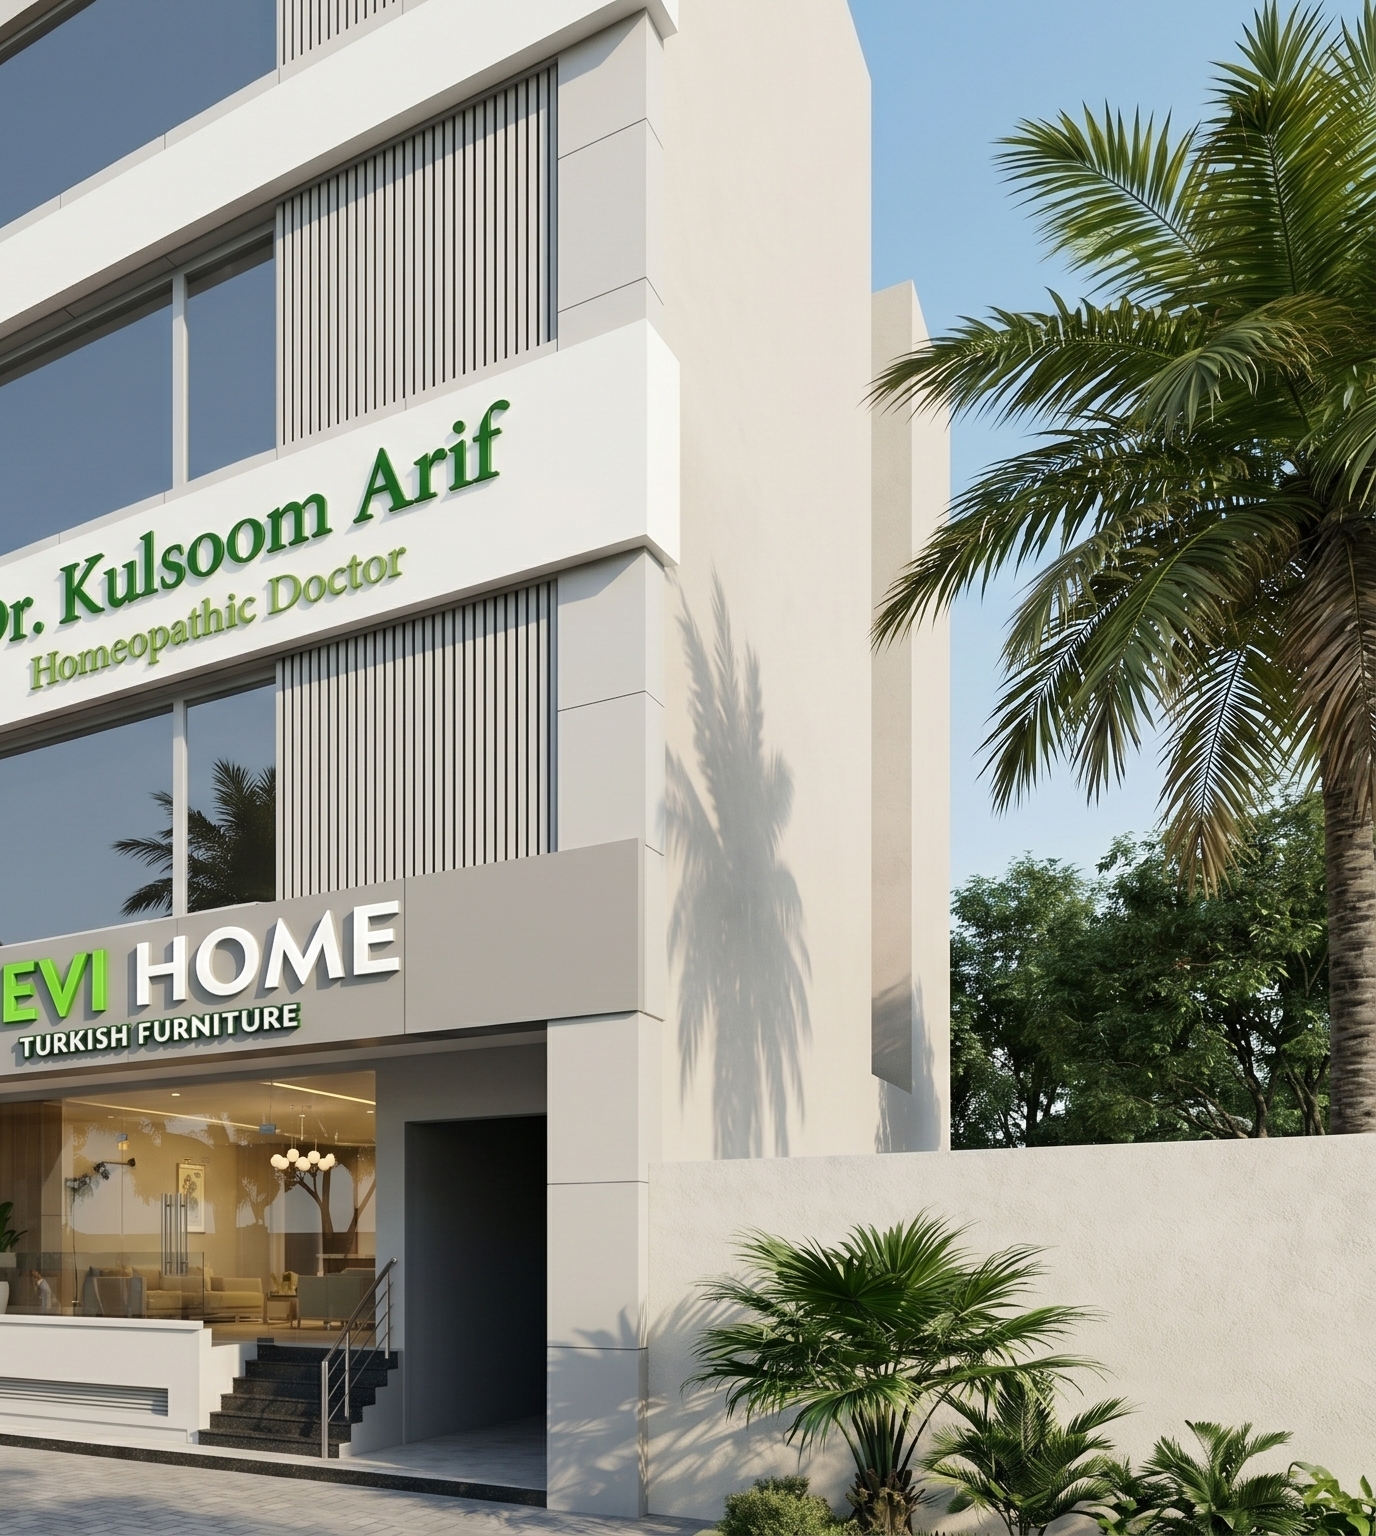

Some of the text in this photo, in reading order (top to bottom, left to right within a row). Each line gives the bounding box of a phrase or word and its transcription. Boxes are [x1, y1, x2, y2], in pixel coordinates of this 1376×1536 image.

[59, 492, 333, 625] Kulsoom
[353, 399, 511, 525] Arif
[30, 546, 407, 692] Homeopathic Doctor
[135, 899, 401, 1006] HOME
[18, 1002, 301, 1058] TURKISH FURNITURE
